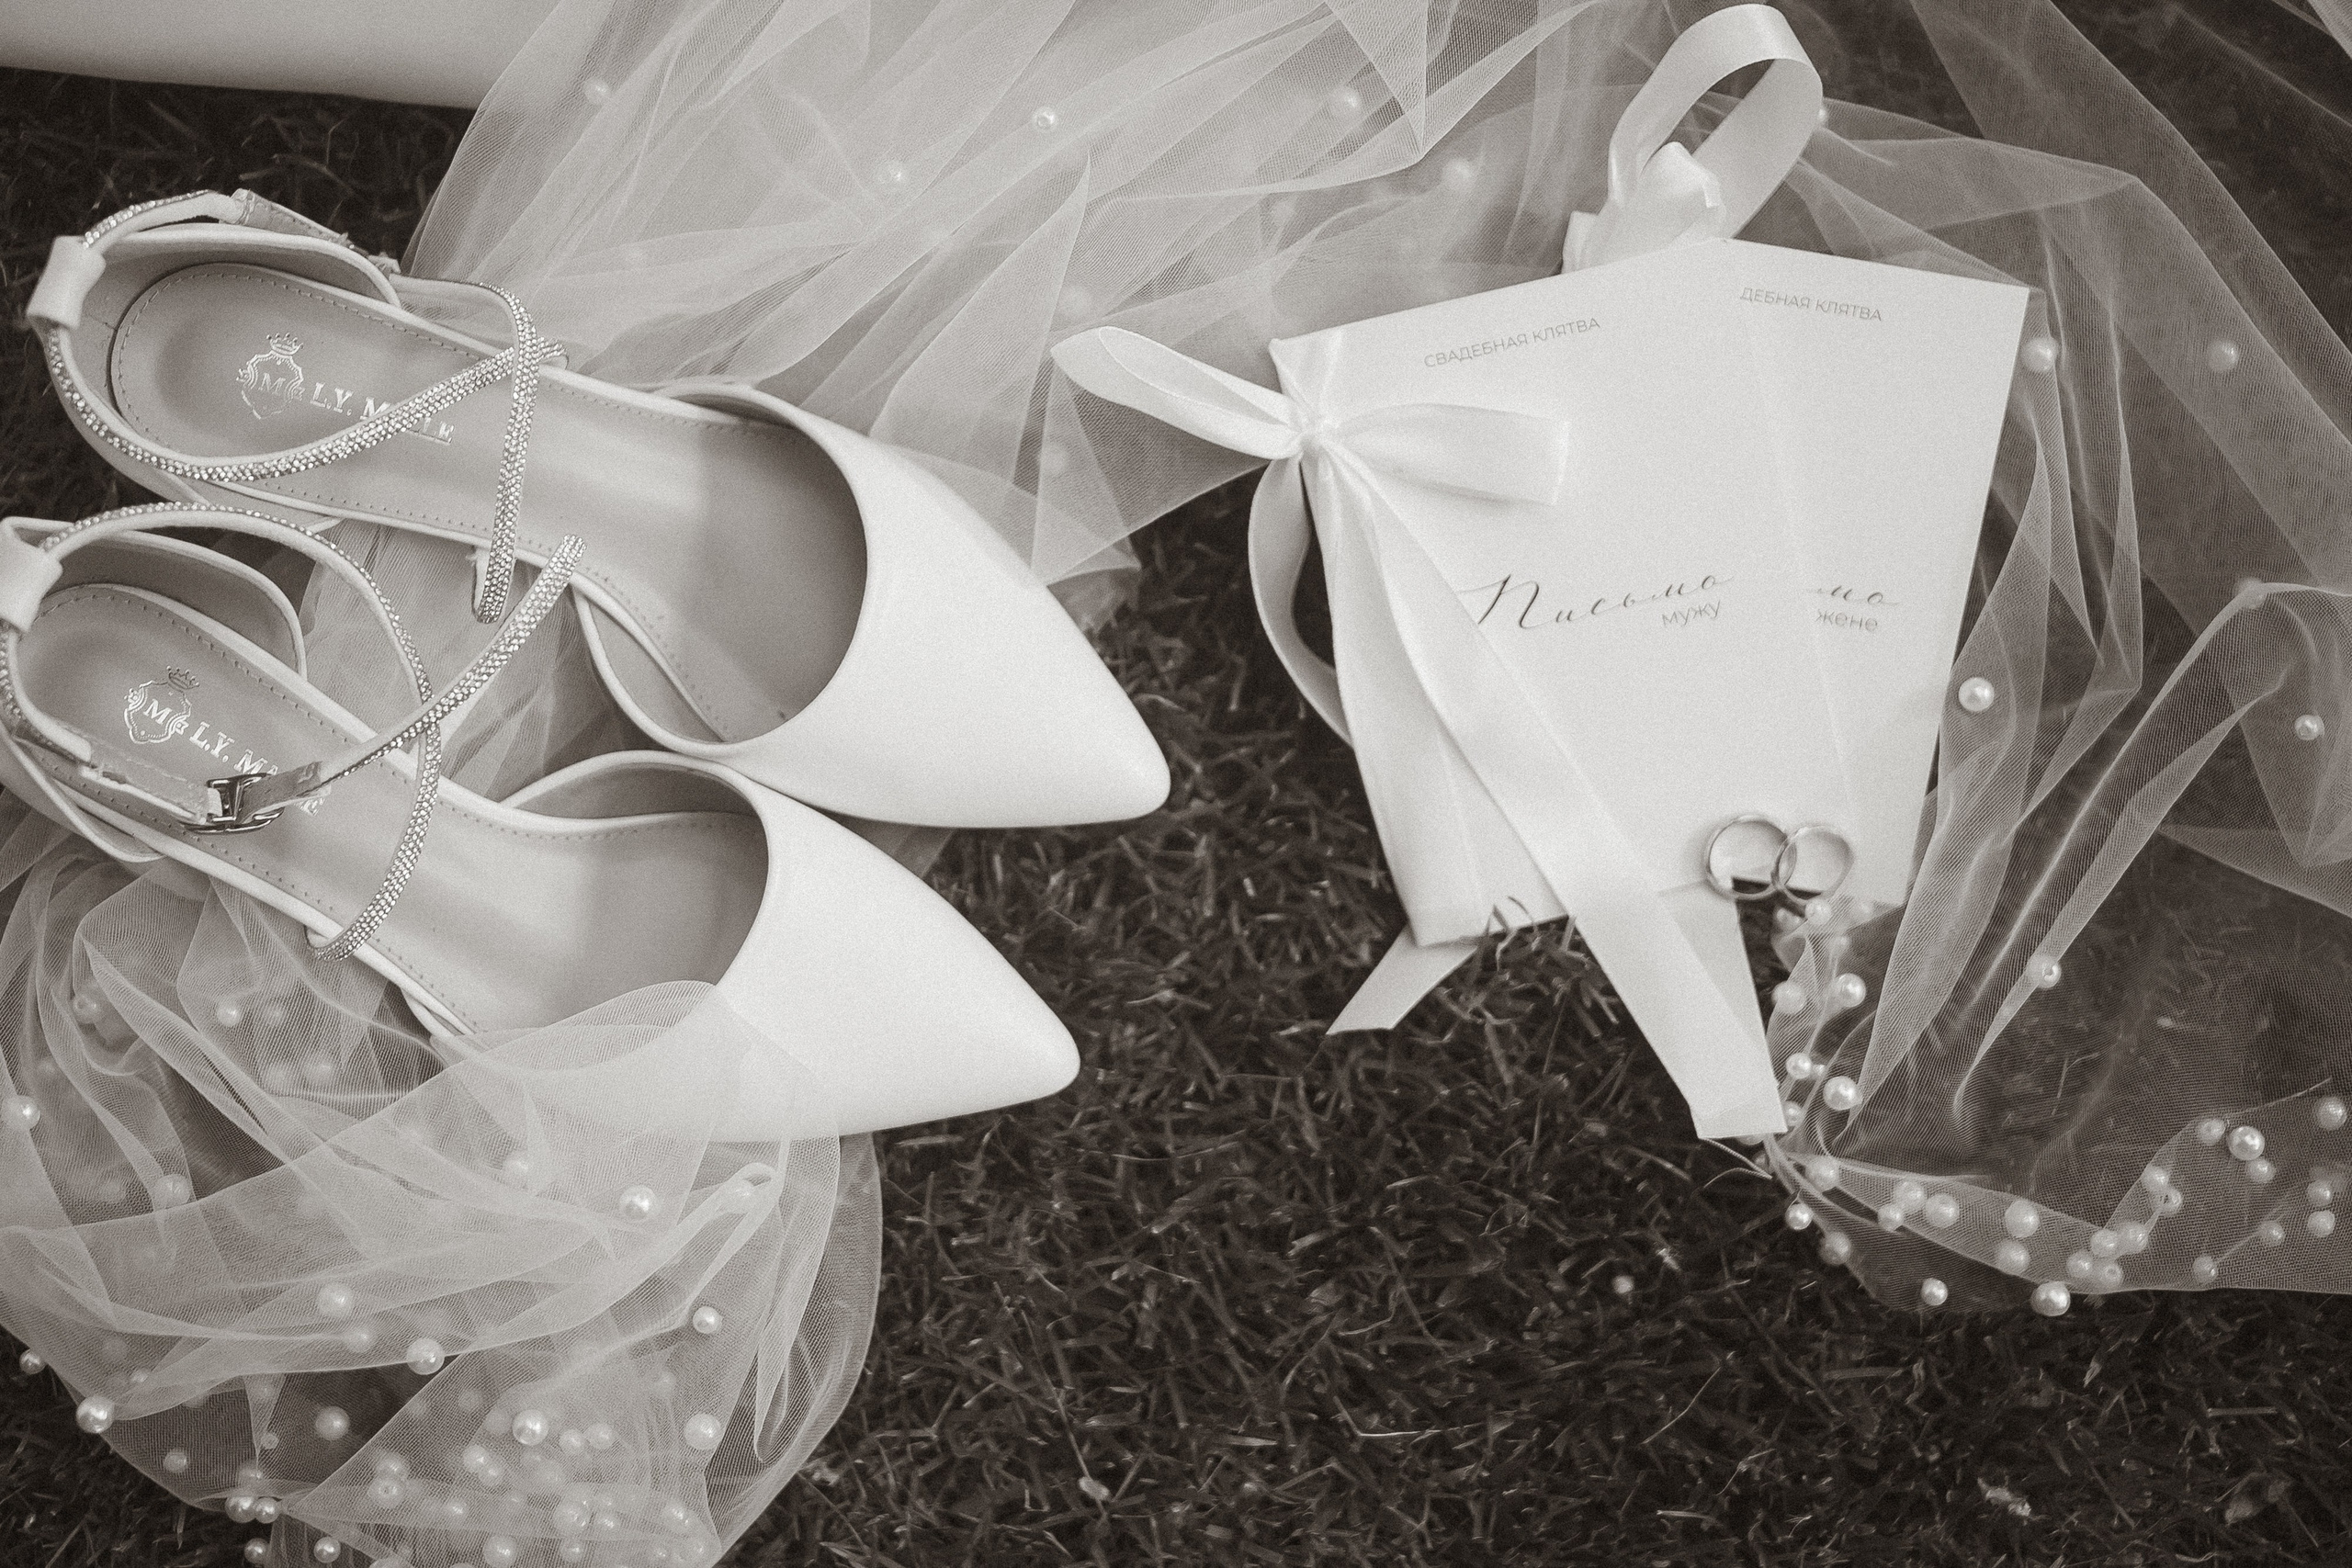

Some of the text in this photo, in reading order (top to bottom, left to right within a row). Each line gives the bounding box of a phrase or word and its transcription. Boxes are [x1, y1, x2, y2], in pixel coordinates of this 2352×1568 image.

[1739, 286, 1883, 321] ДЕБНАЯ КЛЯТВА
[1423, 317, 1600, 367] СВАДЕБНАЯ КЛЯТВА
[1455, 573, 1735, 629] Письмо
[1660, 599, 1722, 627] мужу
[1815, 608, 1878, 633] жене
